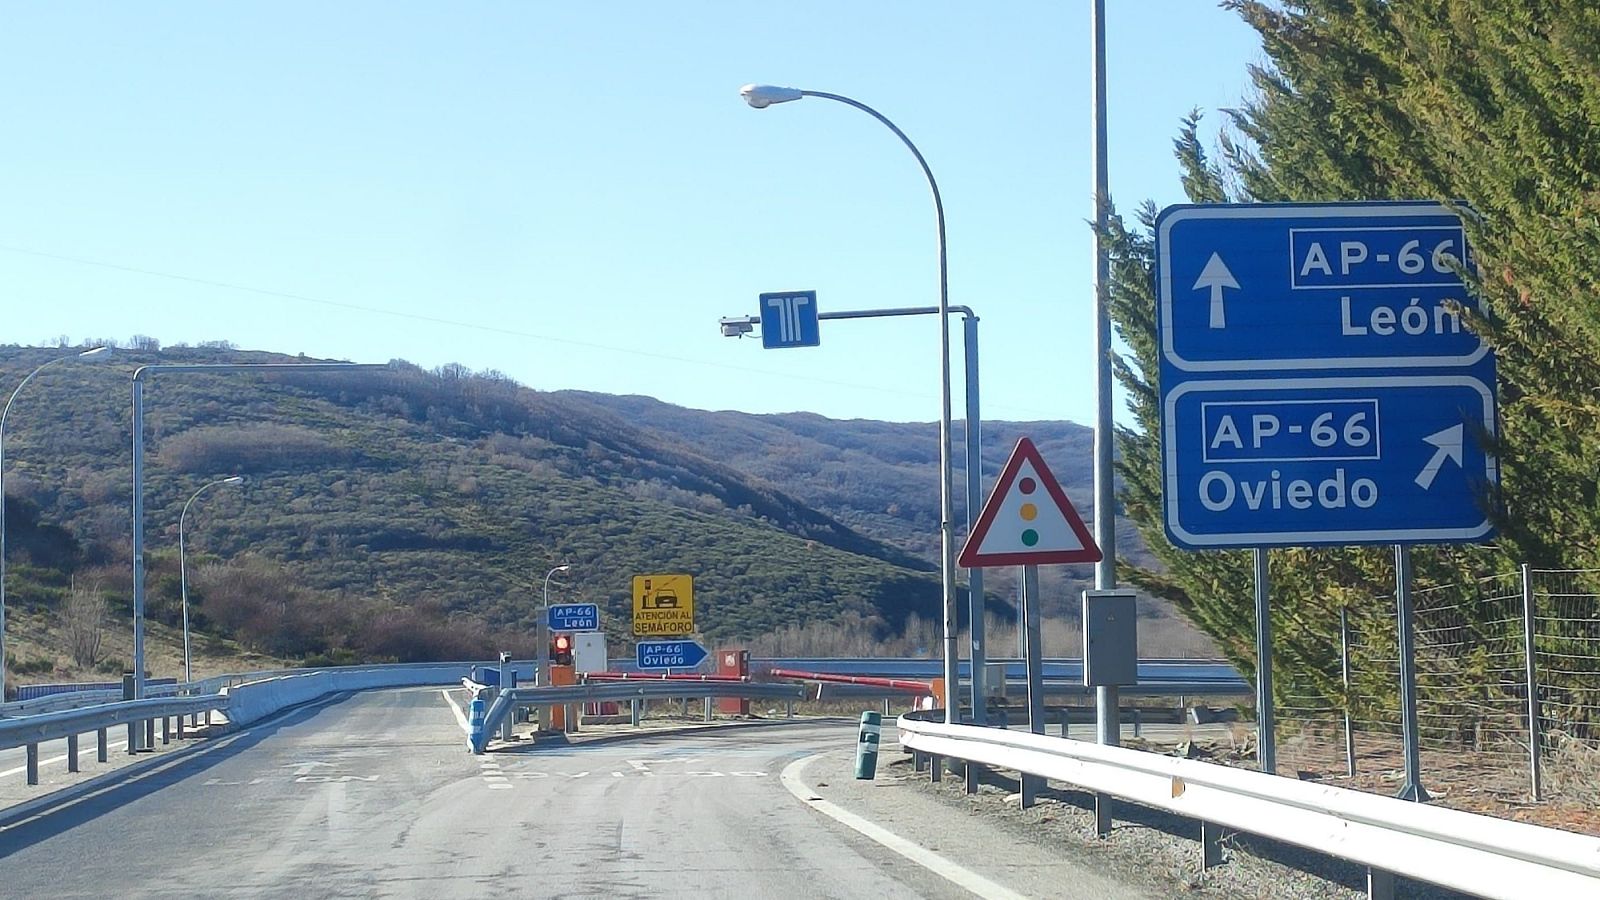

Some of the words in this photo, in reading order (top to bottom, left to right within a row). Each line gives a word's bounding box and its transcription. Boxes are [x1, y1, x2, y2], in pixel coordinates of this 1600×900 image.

[1300, 239, 1458, 276] AP-66
[1341, 297, 1460, 335] León
[1210, 411, 1372, 449] AP-66
[1198, 468, 1378, 512] Oviedo
[556, 606, 593, 617] AP-66
[635, 611, 678, 620] ATENCIÓN
[679, 611, 692, 619] AL
[564, 618, 593, 628] León
[635, 621, 692, 633] SEMÁFORO
[646, 644, 682, 654] AP-66
[643, 654, 684, 665] Oviedo
